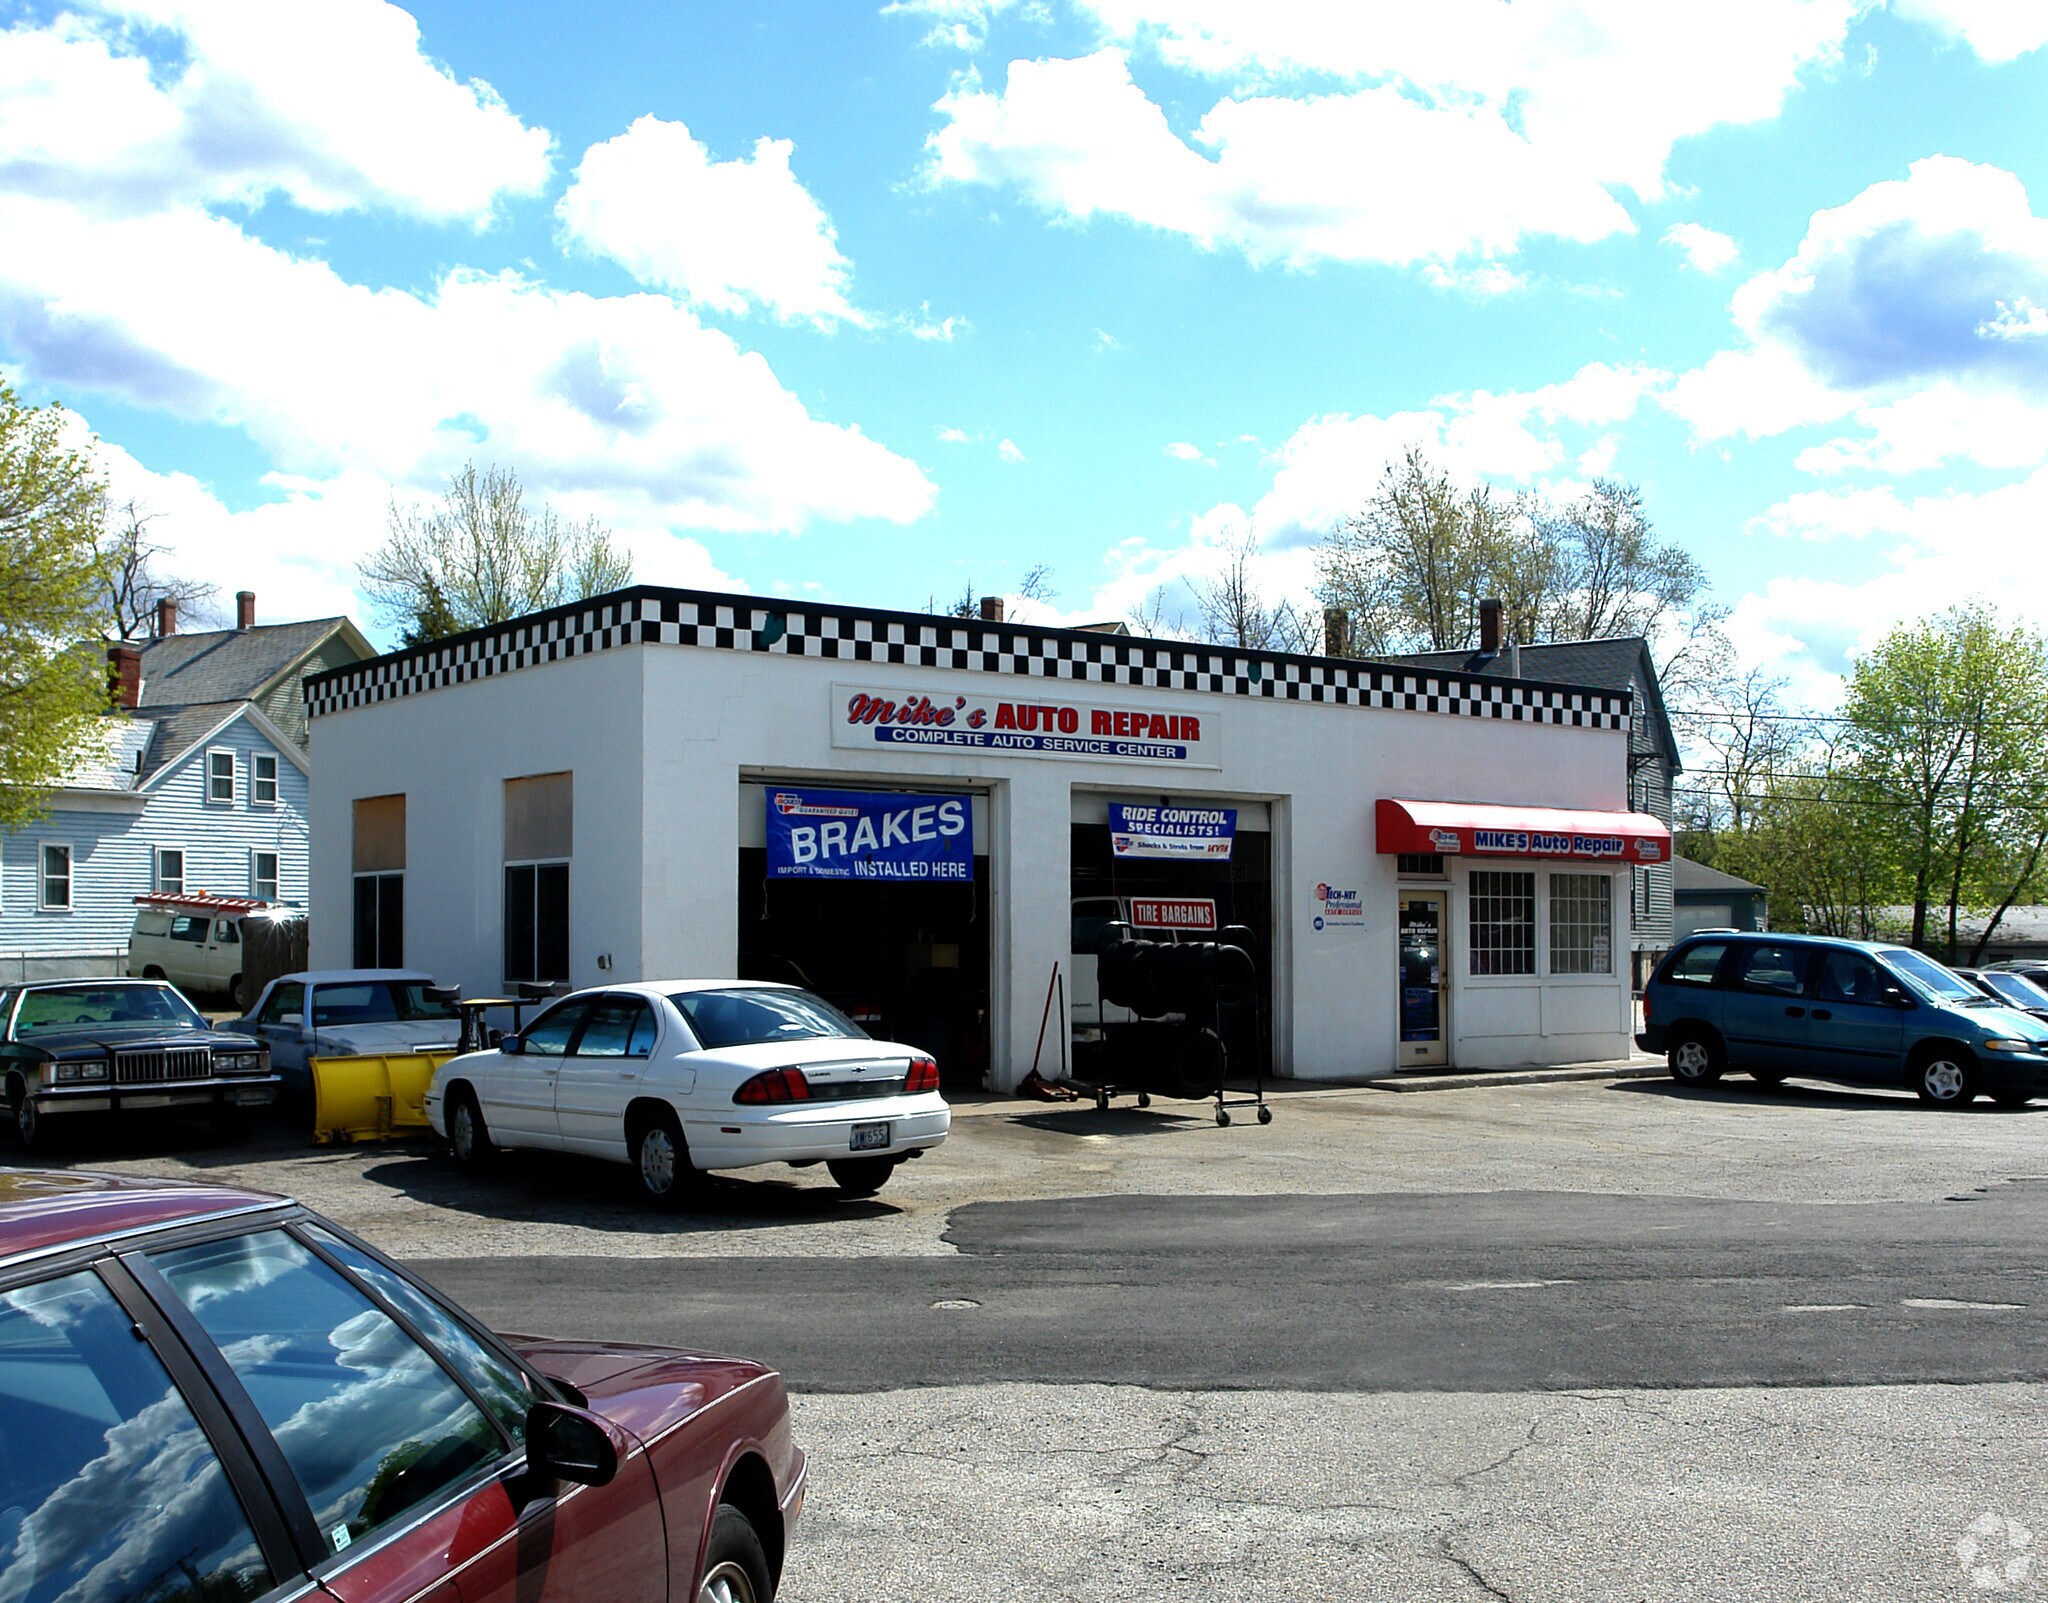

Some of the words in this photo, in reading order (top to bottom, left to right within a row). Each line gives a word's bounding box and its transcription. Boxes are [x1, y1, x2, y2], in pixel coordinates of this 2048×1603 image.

[847, 693, 988, 729] Mike's
[994, 702, 1079, 734] AUTO
[1090, 709, 1200, 742] REPAIR
[892, 728, 985, 746] COMPLETE
[991, 735, 1036, 748] AUTO
[1042, 738, 1110, 754] SERVICE
[1116, 743, 1177, 758] CENTER
[1122, 806, 1157, 822] RIDE
[1160, 808, 1227, 825] CONTROL
[791, 800, 965, 864] BRAKES
[1127, 821, 1220, 836] SPECIALISTS!
[1474, 831, 1528, 849] MIKE'S
[1531, 834, 1569, 850] Auto
[1574, 836, 1624, 854] Repair
[777, 866, 807, 874] IMPORT
[854, 860, 928, 878] INSTALLED
[932, 861, 967, 877] HERE
[1137, 904, 1159, 922] TIRE
[1161, 905, 1211, 924] BARGAINS
